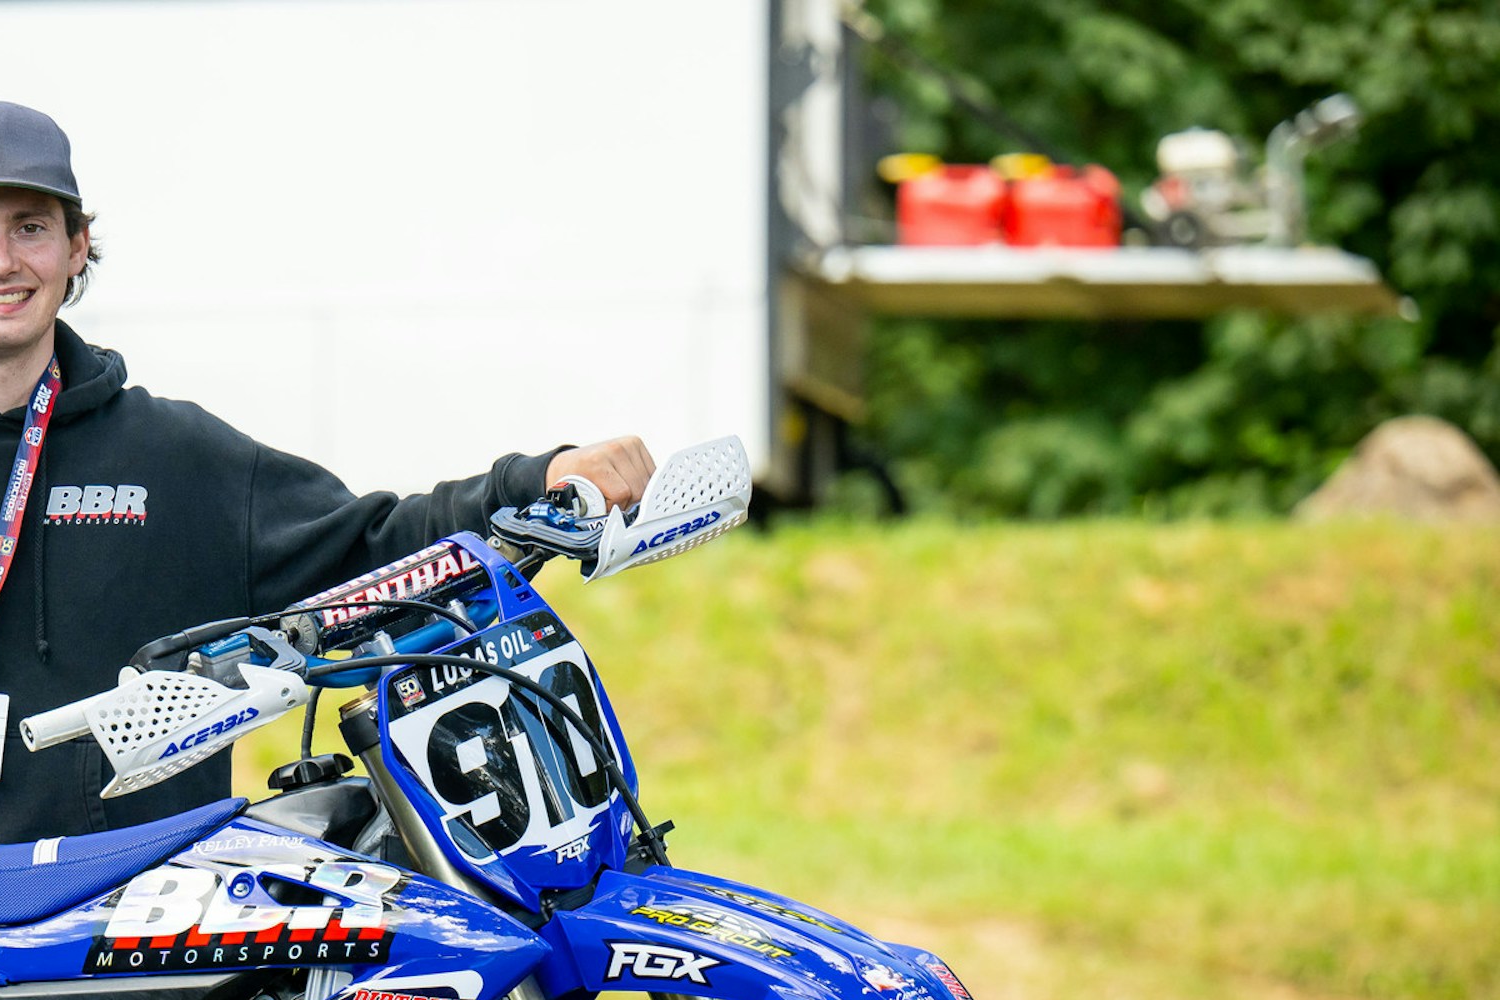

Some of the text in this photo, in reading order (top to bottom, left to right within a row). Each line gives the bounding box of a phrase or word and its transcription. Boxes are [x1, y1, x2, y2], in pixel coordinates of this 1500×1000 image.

[32, 383, 52, 413] 2022
[46, 485, 148, 515] BBR
[43, 518, 145, 527] MOTORSPORTS
[501, 629, 531, 659] OIL
[427, 660, 610, 860] 910
[193, 836, 307, 854] KELLEY FARM
[556, 836, 592, 864] FGX
[104, 861, 401, 938] BBR
[631, 906, 690, 926] PRO
[693, 921, 793, 958] CIRCUIT
[96, 943, 380, 967] MOTORSPORTS
[607, 943, 720, 984] FGX
